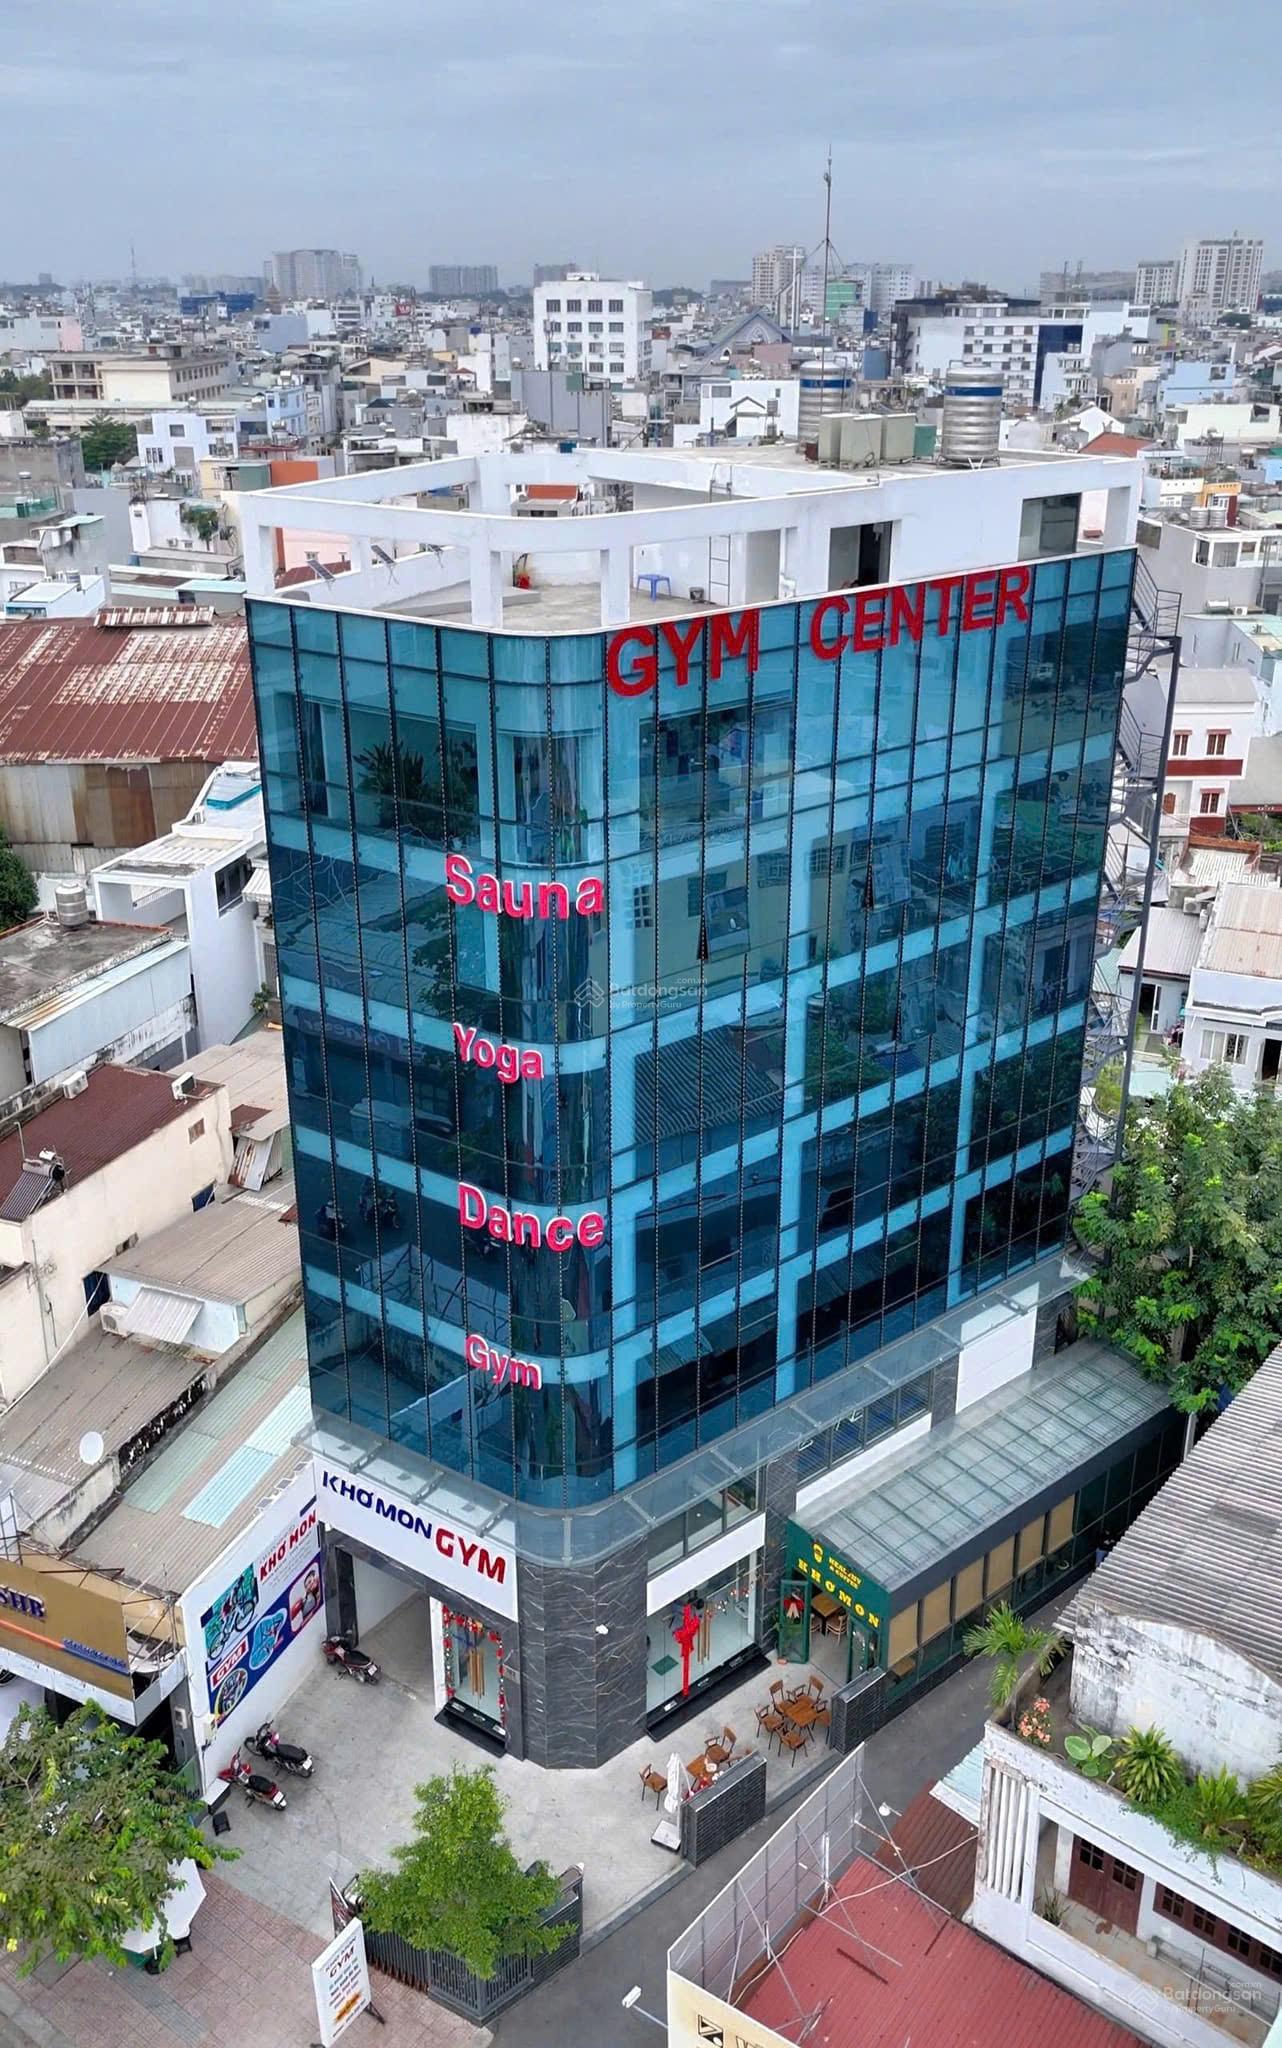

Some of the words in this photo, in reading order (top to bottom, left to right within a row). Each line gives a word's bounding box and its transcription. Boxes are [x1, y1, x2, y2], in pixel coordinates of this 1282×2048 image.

[606, 609, 760, 697] GYM
[810, 566, 1030, 660] CENTER
[445, 854, 605, 919] Sauna
[453, 1022, 544, 1083] Yoga
[458, 1182, 605, 1253] Dance
[466, 1334, 542, 1391] Gym
[290, 1509, 317, 1549] MON
[436, 1528, 506, 1584] GYM
[215, 1644, 246, 1681] GYM
[329, 1945, 355, 1978] GYM
